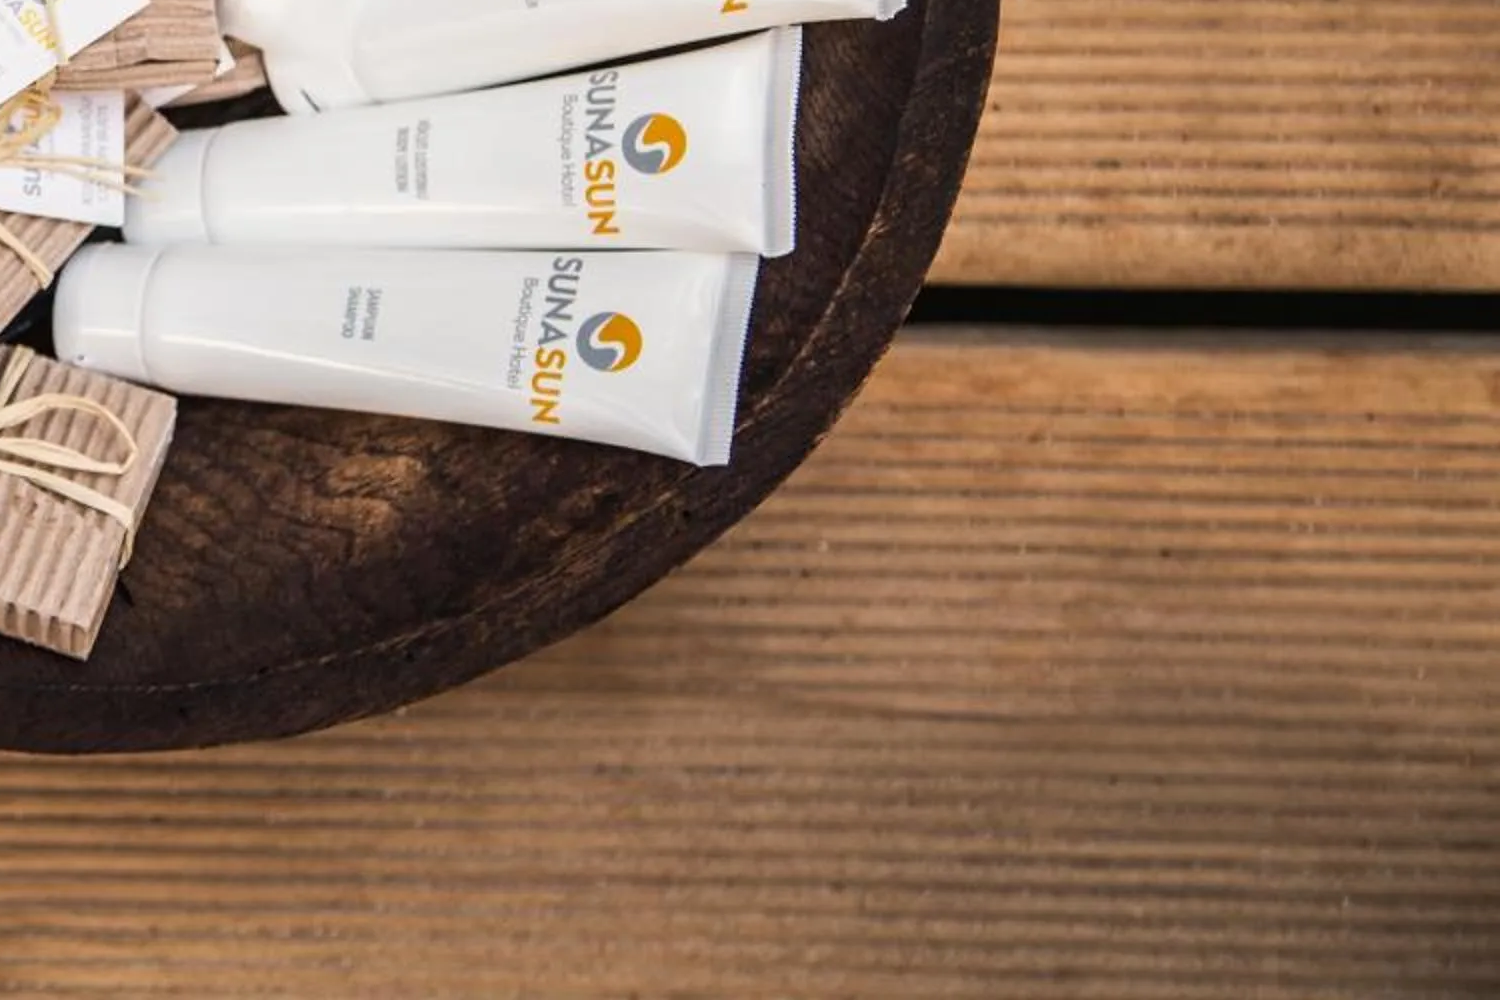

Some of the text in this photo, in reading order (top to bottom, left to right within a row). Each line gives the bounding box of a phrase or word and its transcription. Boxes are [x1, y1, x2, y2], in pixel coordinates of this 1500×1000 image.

[557, 93, 579, 207] Boutique Hotel
[585, 70, 621, 235] SUNASUN
[506, 276, 541, 390] Boutique Hotel
[529, 256, 584, 425] SUNASUN
